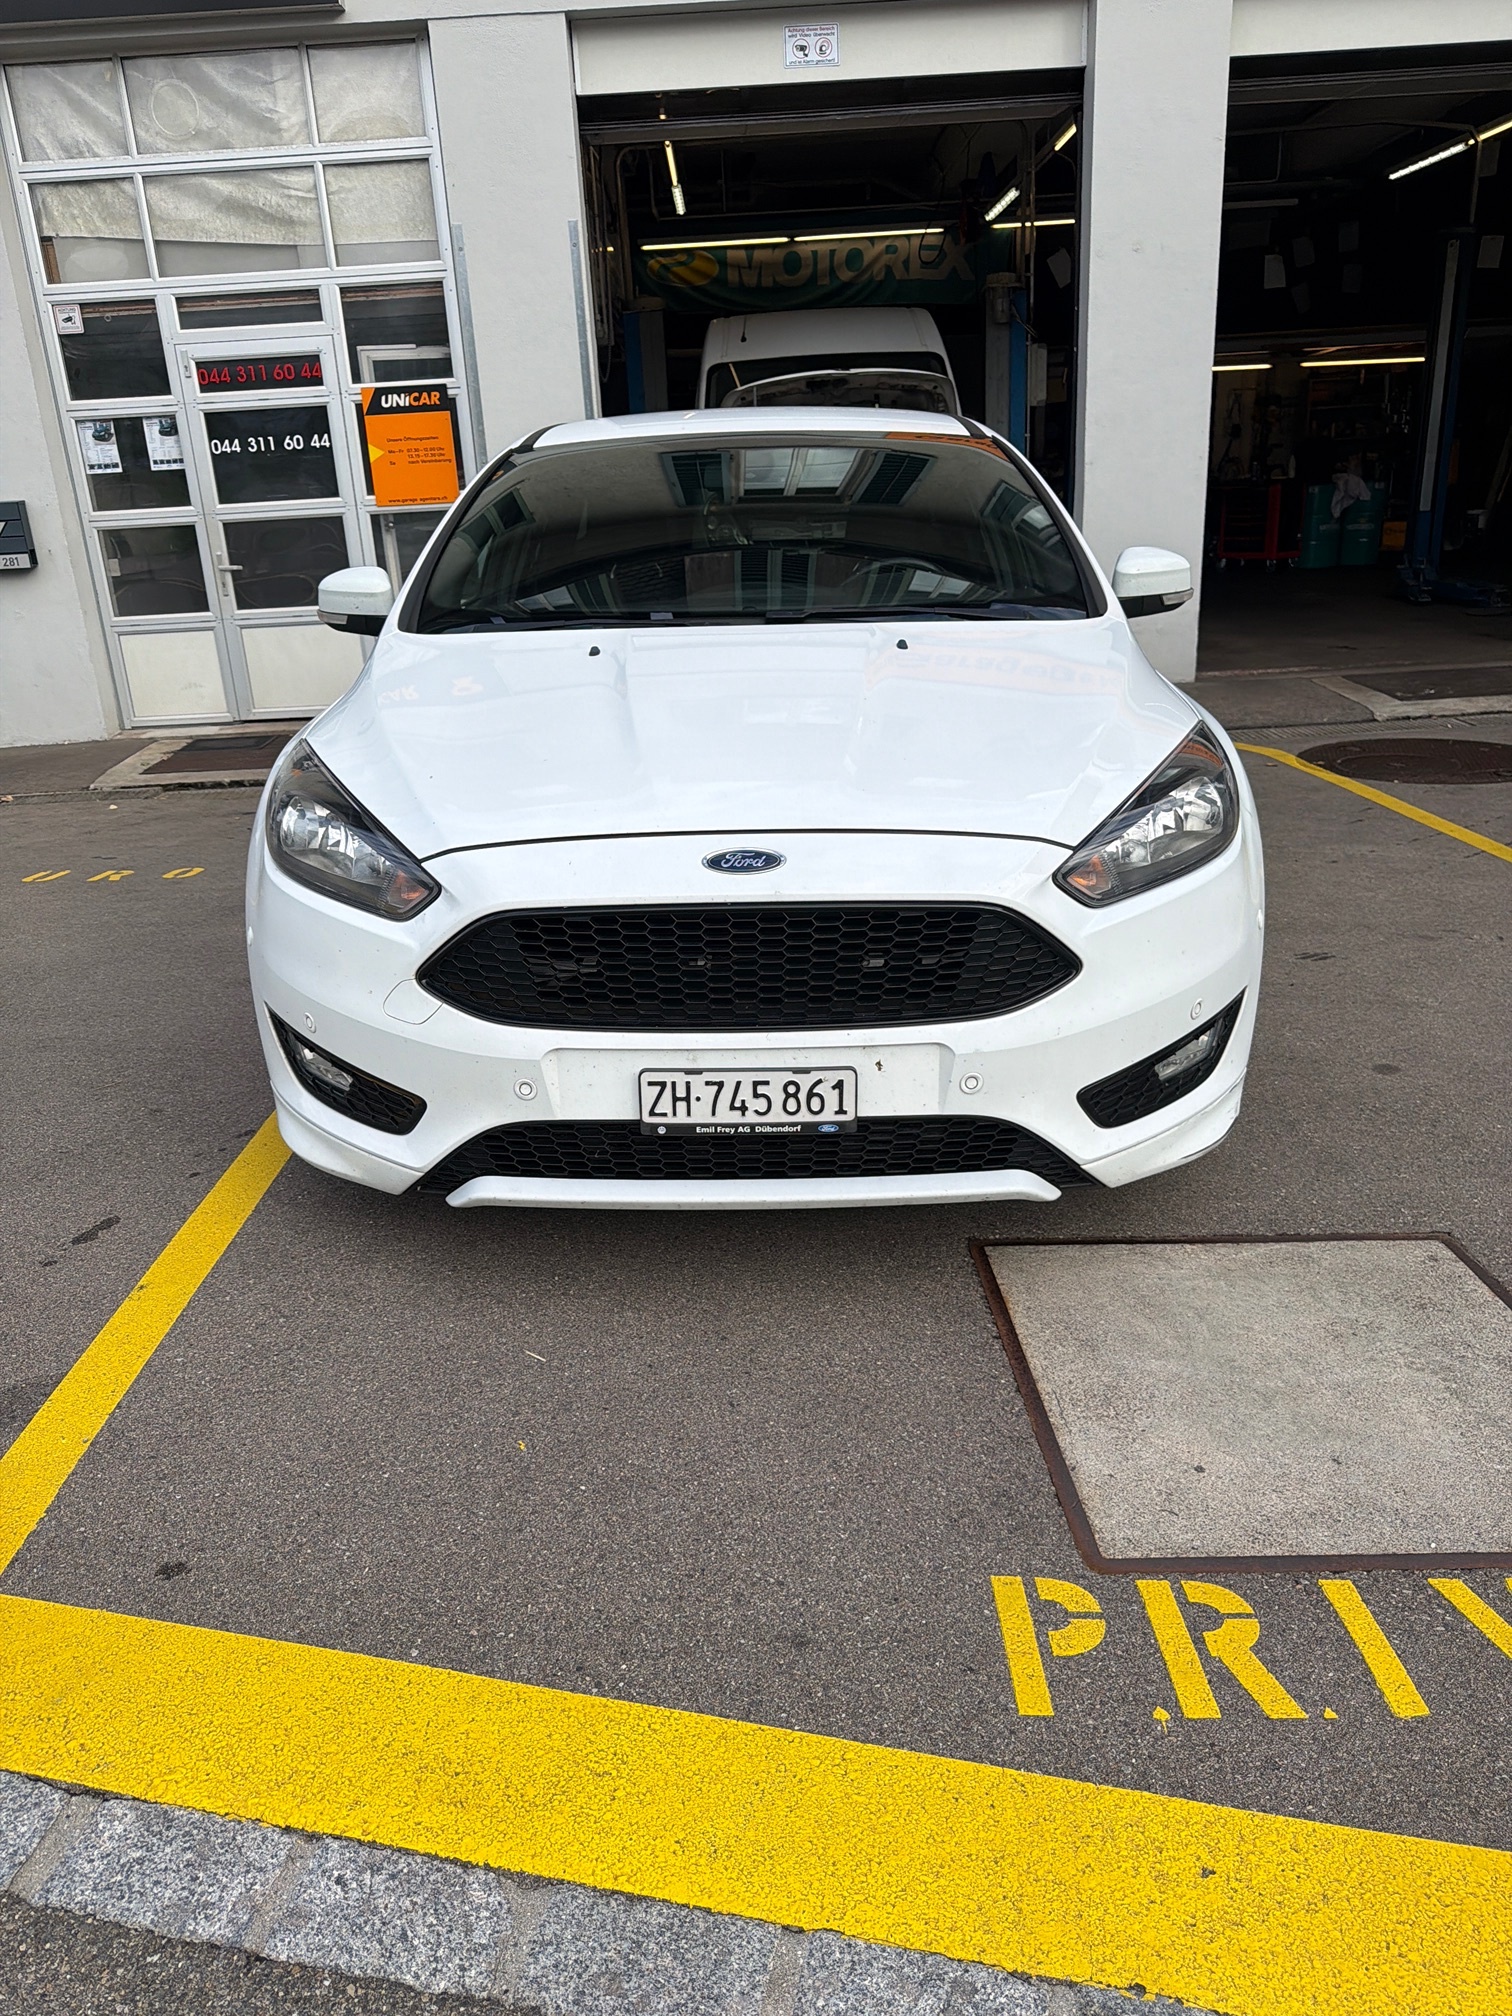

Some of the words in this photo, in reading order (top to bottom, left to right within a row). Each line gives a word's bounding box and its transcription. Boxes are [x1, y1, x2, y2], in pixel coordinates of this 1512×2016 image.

[726, 233, 976, 288] MOTOREX
[198, 367, 231, 385] 044
[236, 365, 267, 382] 311
[273, 363, 295, 380] 60
[301, 362, 322, 378] 44
[211, 439, 241, 454] 044
[247, 436, 275, 453] 311
[283, 435, 304, 450] 60
[310, 433, 331, 449] 44
[2, 557, 20, 567] 281
[721, 852, 767, 868] Ford
[717, 1126, 736, 1135] Frey
[755, 1125, 802, 1133] Dübendorf
